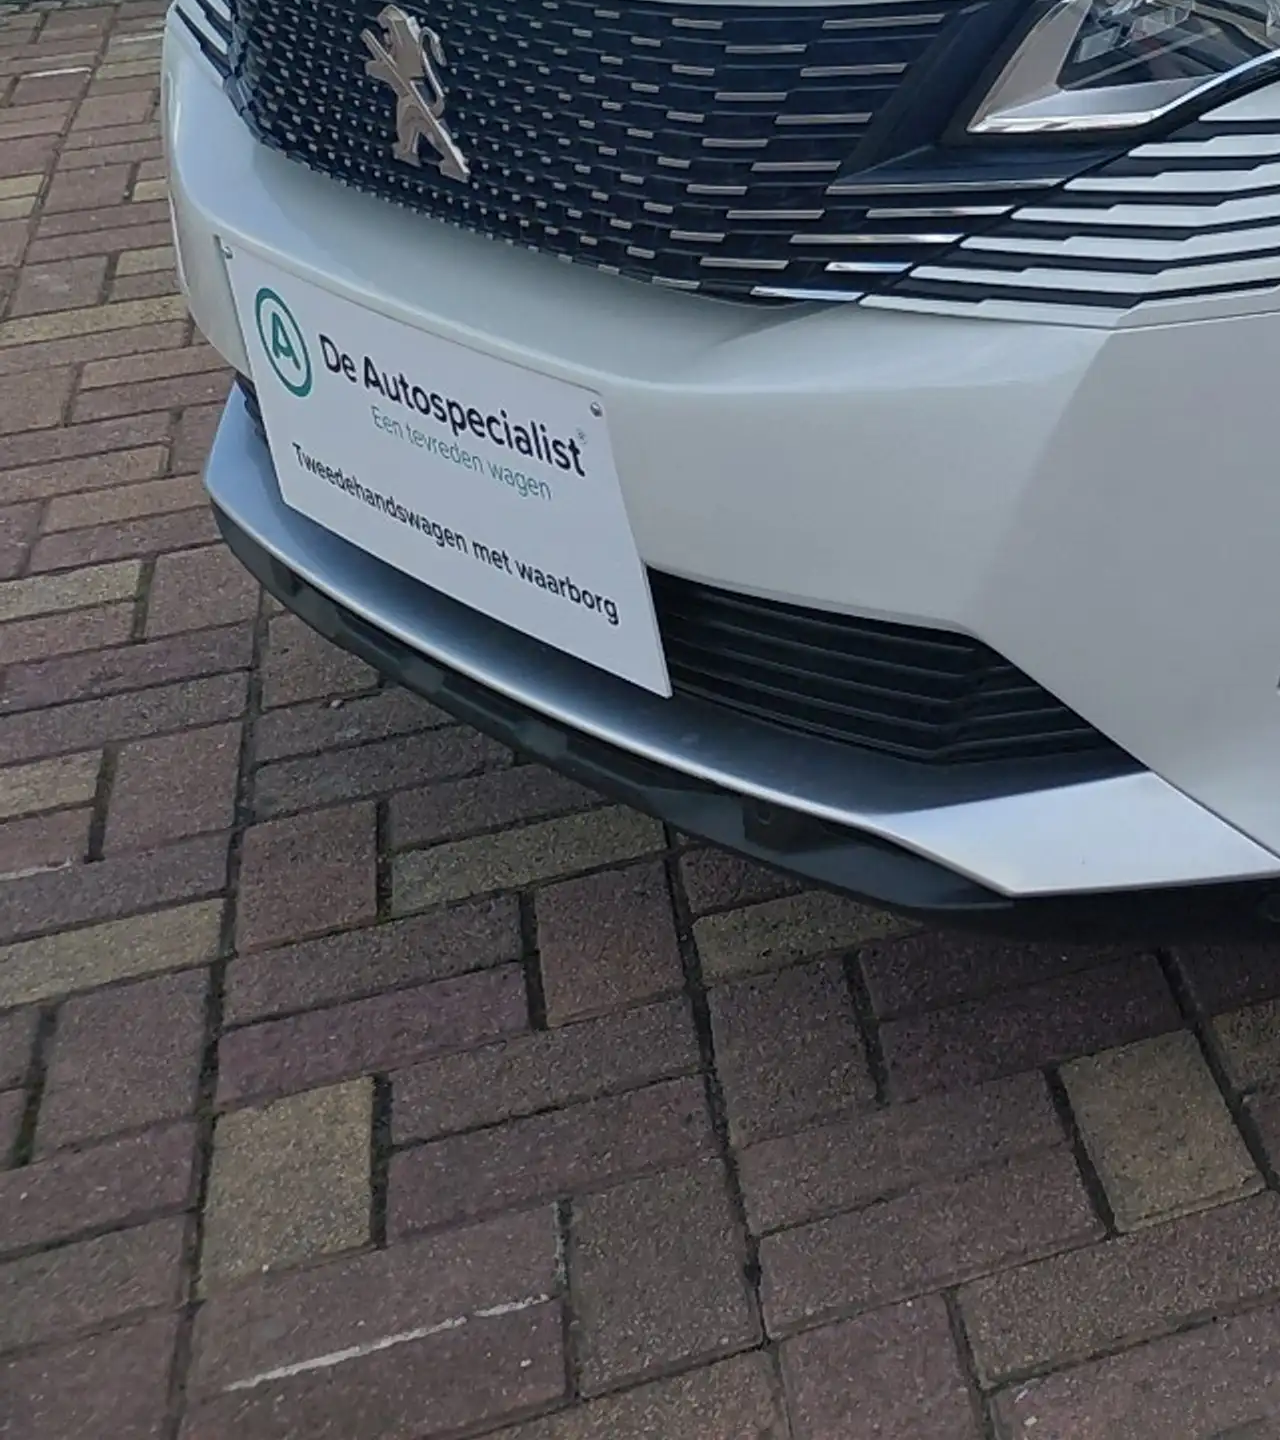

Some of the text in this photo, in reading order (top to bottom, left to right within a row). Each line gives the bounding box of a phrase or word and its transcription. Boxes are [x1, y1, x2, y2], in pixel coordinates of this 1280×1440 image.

[319, 333, 586, 478] De Autospecialist
[371, 404, 553, 503] Een tevreden wagen
[291, 441, 621, 629] Tweedehandswagen met waarborg
